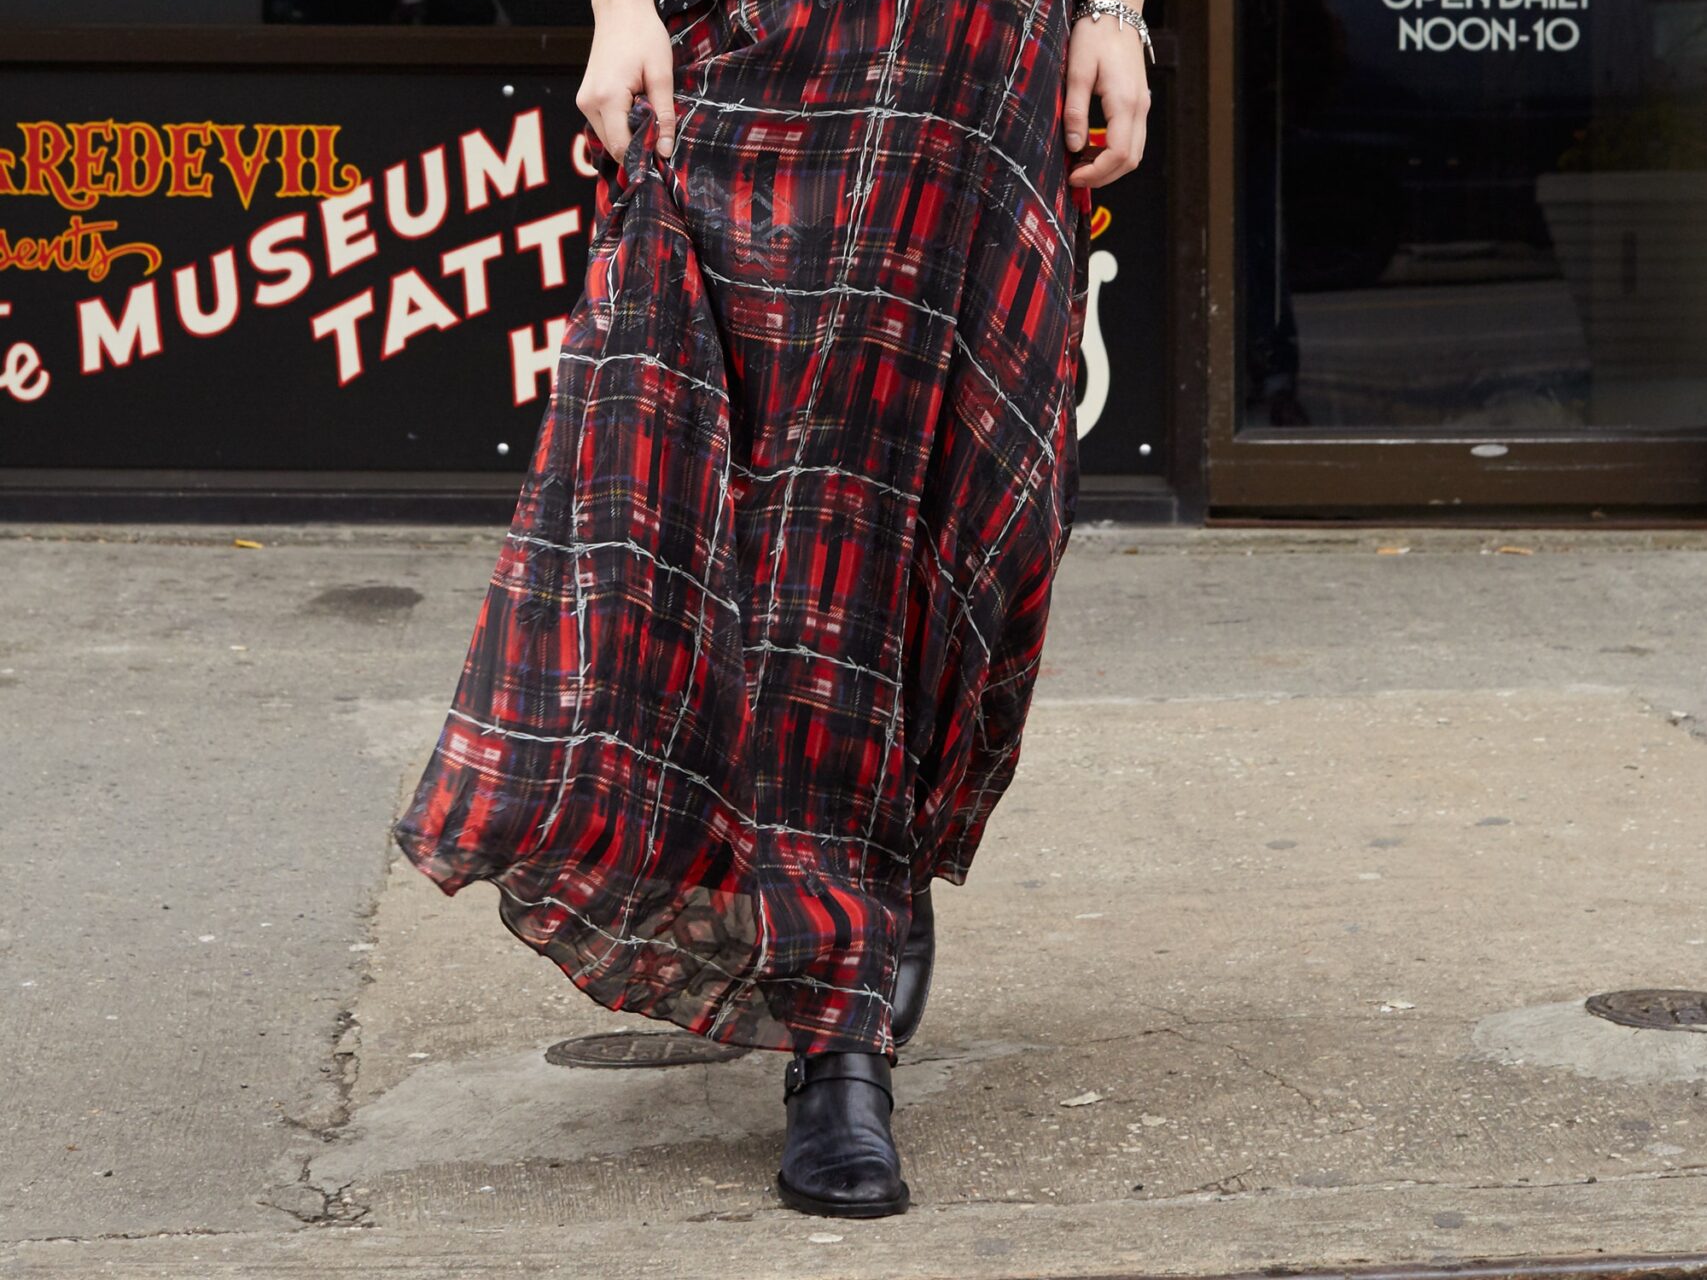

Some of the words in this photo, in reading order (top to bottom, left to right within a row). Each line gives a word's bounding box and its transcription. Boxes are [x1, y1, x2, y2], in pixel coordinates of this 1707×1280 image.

[1399, 17, 1580, 52] NOON-10
[76, 107, 547, 375] MUSEUM
[311, 206, 598, 387] TATT
